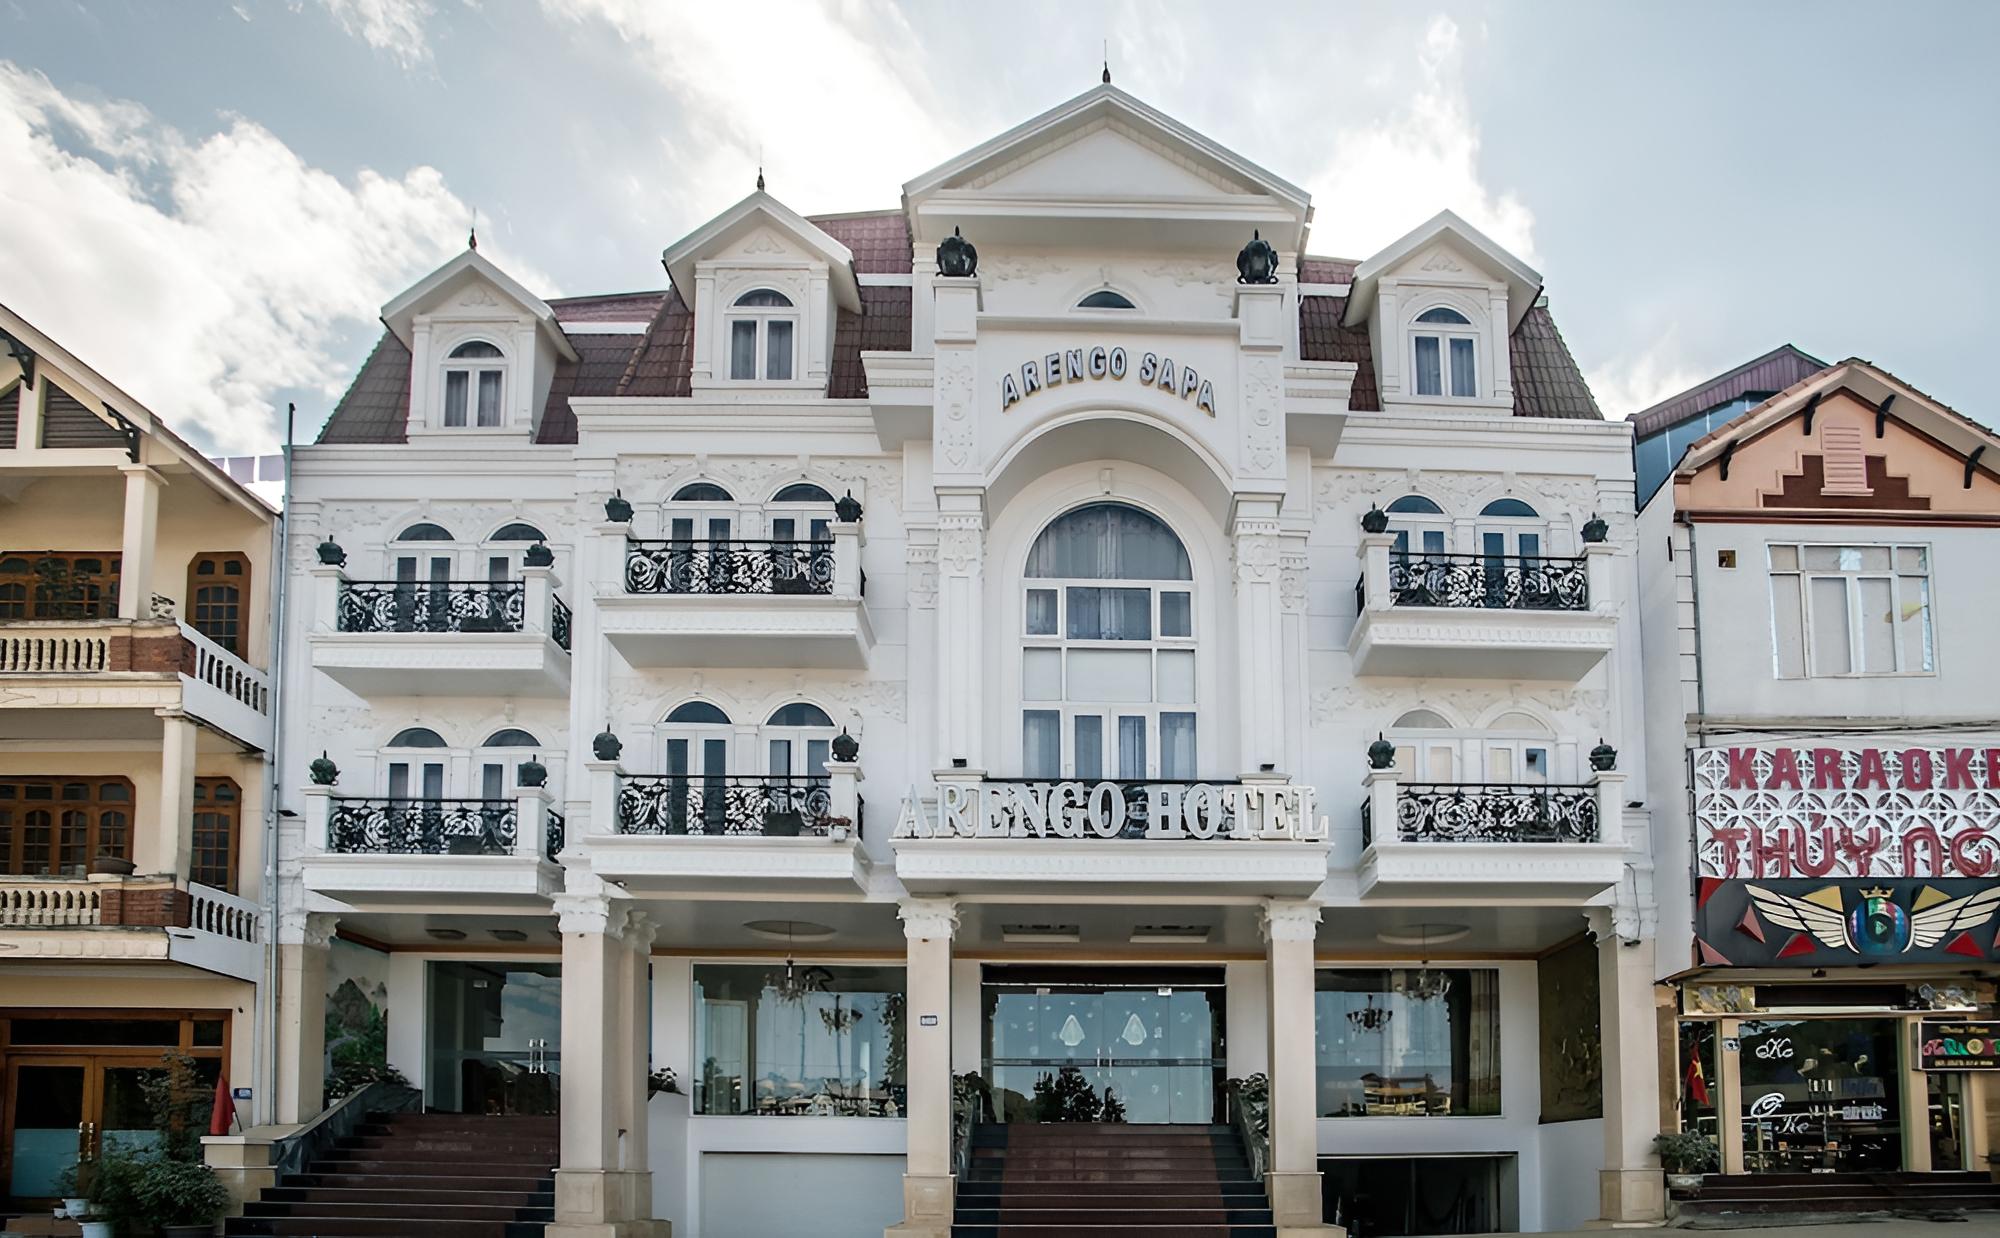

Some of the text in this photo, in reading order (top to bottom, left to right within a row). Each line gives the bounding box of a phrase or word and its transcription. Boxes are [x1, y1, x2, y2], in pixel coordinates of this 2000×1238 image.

[1002, 346, 1216, 418] ARENGO SAPA
[893, 781, 1330, 842] ARENGO HOTEL
